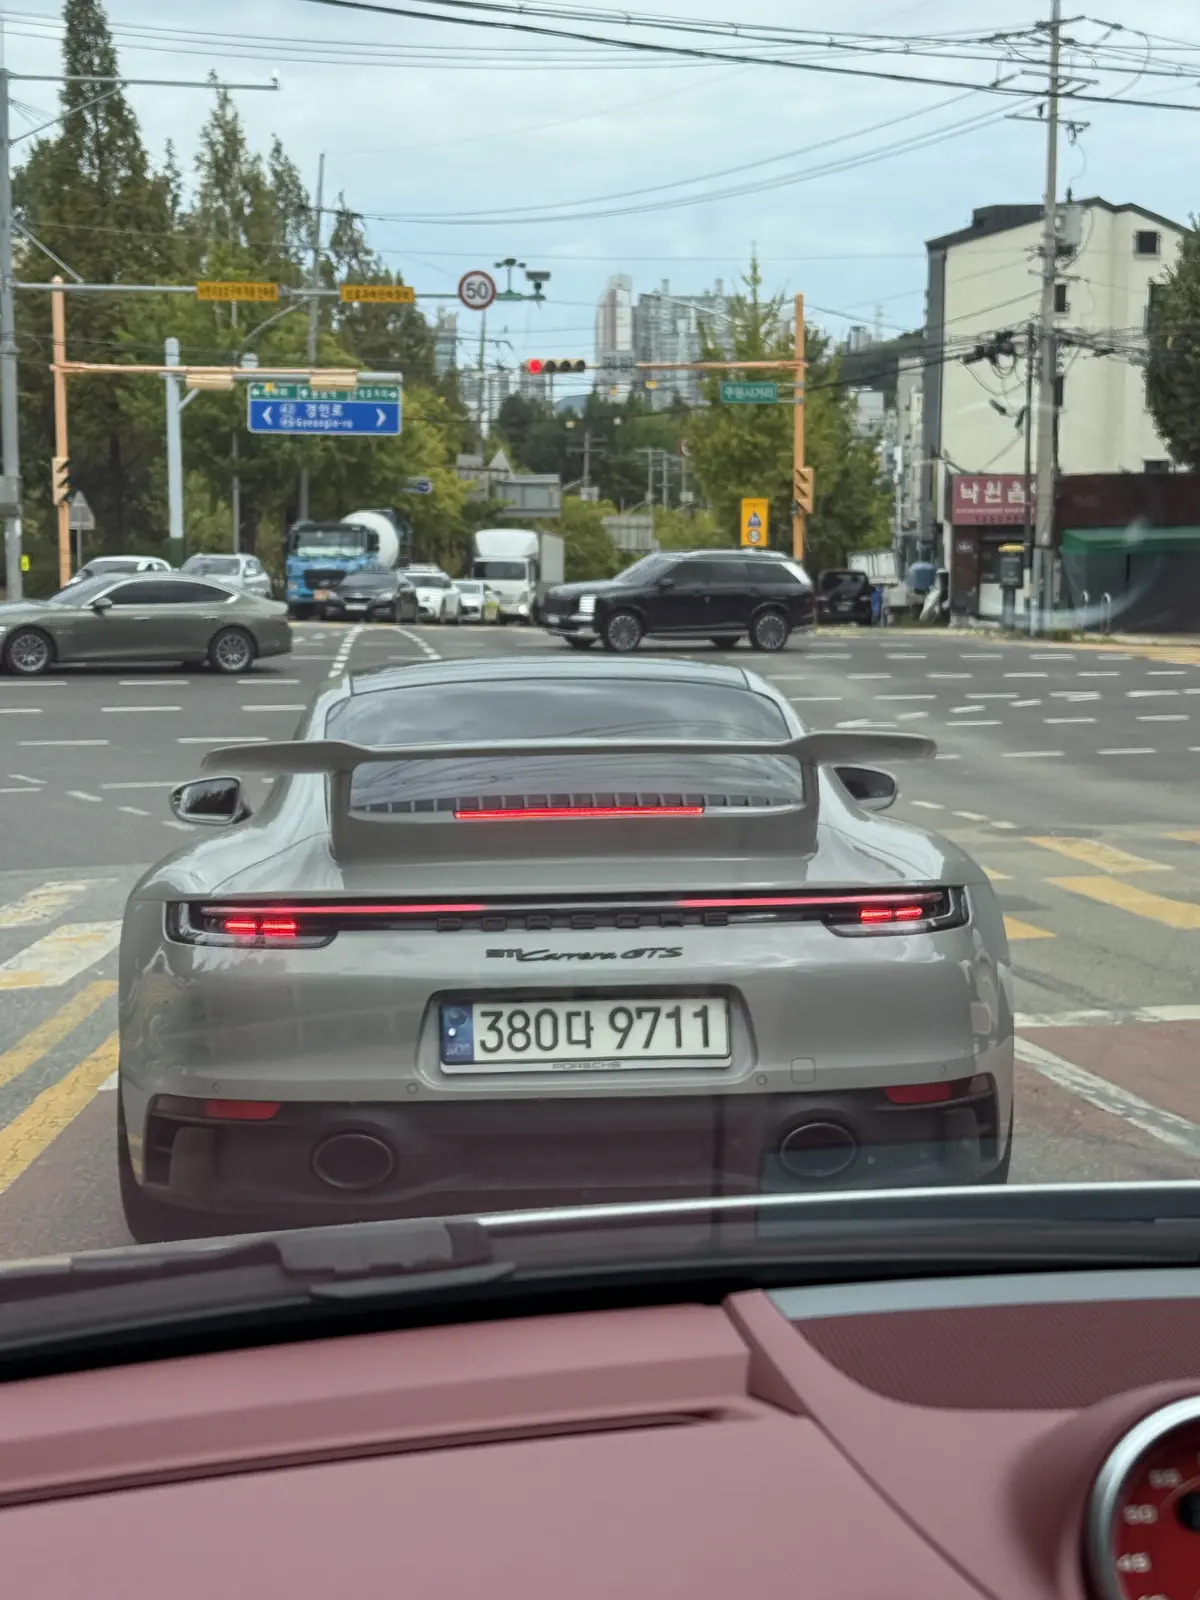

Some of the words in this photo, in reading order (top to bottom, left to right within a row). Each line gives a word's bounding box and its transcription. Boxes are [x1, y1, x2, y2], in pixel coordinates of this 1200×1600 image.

[466, 280, 489, 300] 50
[305, 404, 343, 418] 경인로
[517, 949, 617, 962] Carrera
[620, 946, 683, 960] GTS
[479, 1008, 594, 1053] 380다
[608, 1004, 710, 1050] 9711
